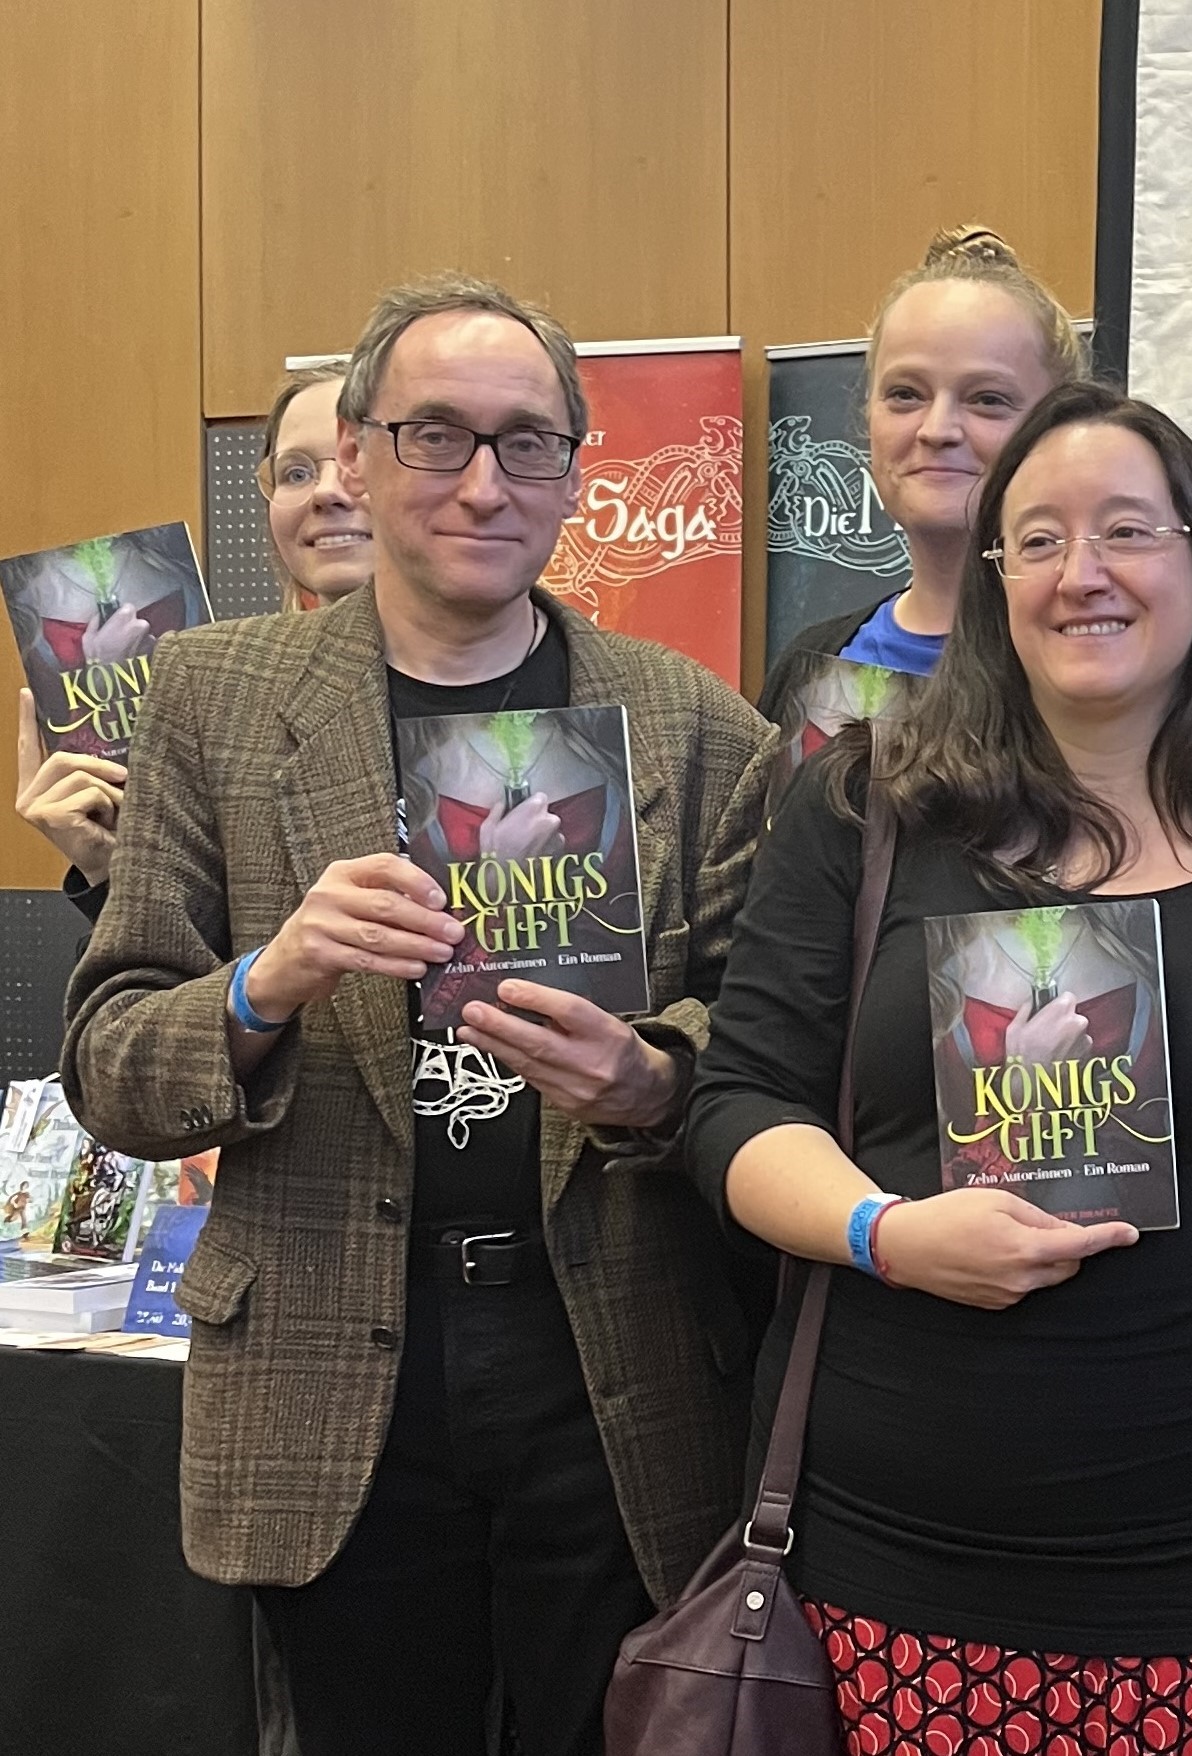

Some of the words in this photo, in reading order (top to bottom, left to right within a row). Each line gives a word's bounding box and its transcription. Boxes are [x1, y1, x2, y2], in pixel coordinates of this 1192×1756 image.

[803, 496, 857, 537] Die
[58, 654, 151, 712] KÖNI
[446, 852, 609, 911] KÖNIGS
[475, 900, 577, 954] GIFT
[444, 962, 475, 975] Zehn
[476, 957, 547, 973] Autor:innen
[558, 953, 578, 966] Ein
[580, 951, 622, 964] Roman
[969, 1055, 1137, 1121] KÖNIGS
[1000, 1107, 1104, 1164] GIFT
[966, 1173, 999, 1187] Zehn
[1000, 1167, 1073, 1184] Autor:innen
[1084, 1163, 1104, 1176] Ein
[1107, 1162, 1150, 1175] Roman
